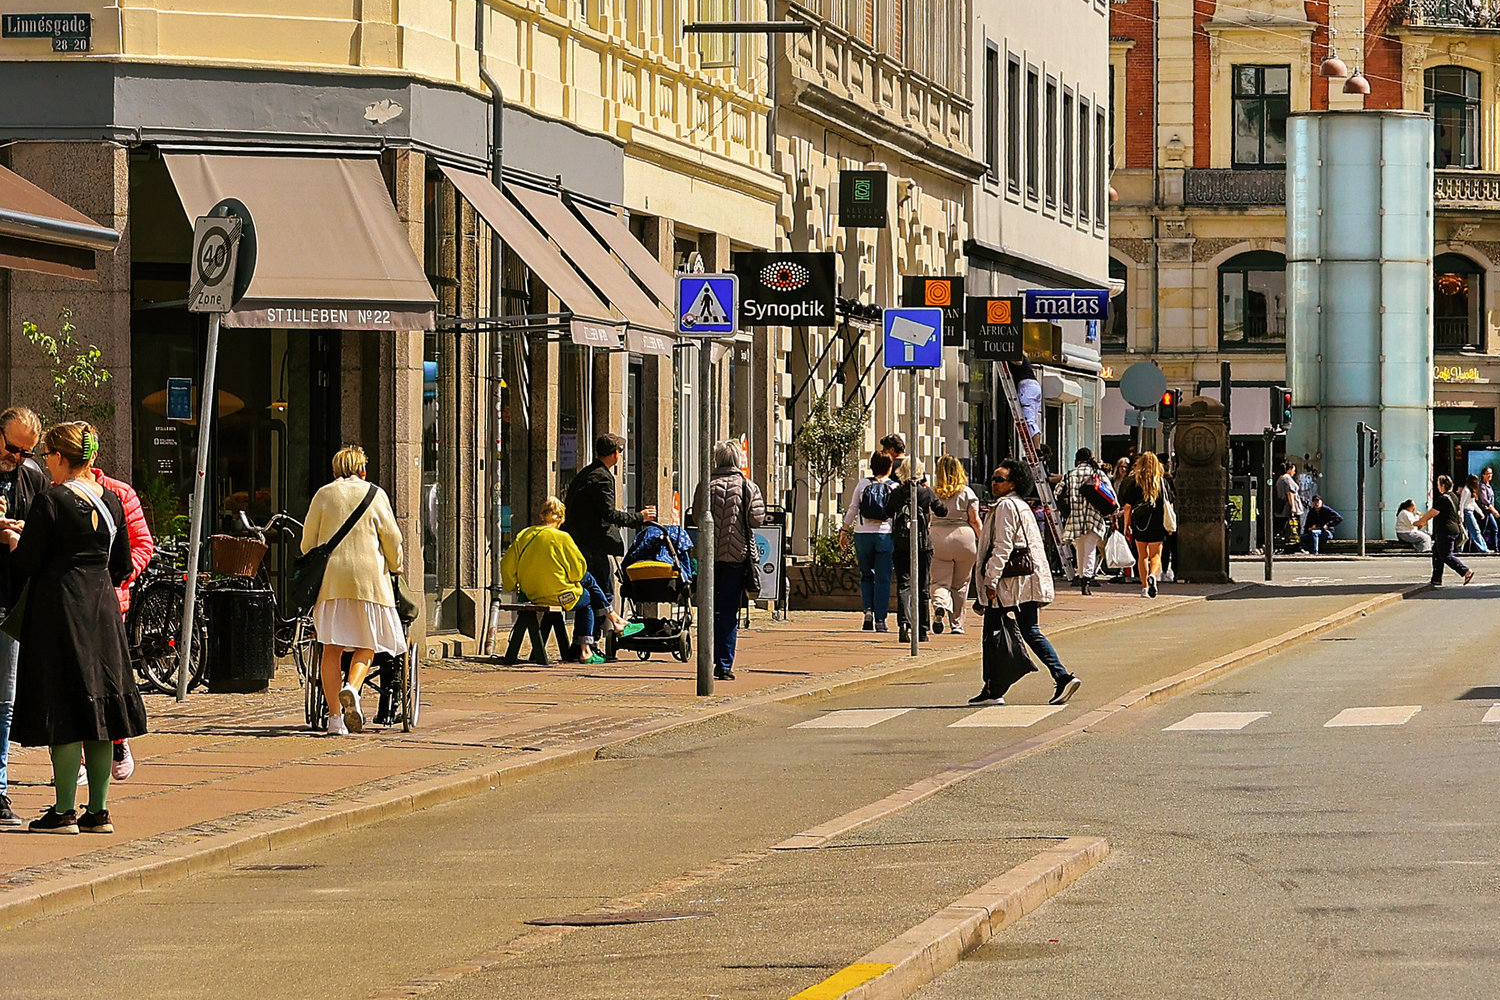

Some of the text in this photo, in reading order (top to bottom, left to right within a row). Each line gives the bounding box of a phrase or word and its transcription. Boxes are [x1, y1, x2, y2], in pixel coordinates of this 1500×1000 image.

[7, 15, 86, 36] Linnésgade
[203, 244, 226, 267] 40
[198, 292, 222, 305] Zone
[1034, 292, 1100, 315] matas
[267, 308, 349, 324] STILLEBEN
[743, 299, 825, 320] Synoptik
[978, 324, 1019, 336] AFRICAN
[983, 340, 1015, 353] TOUCH
